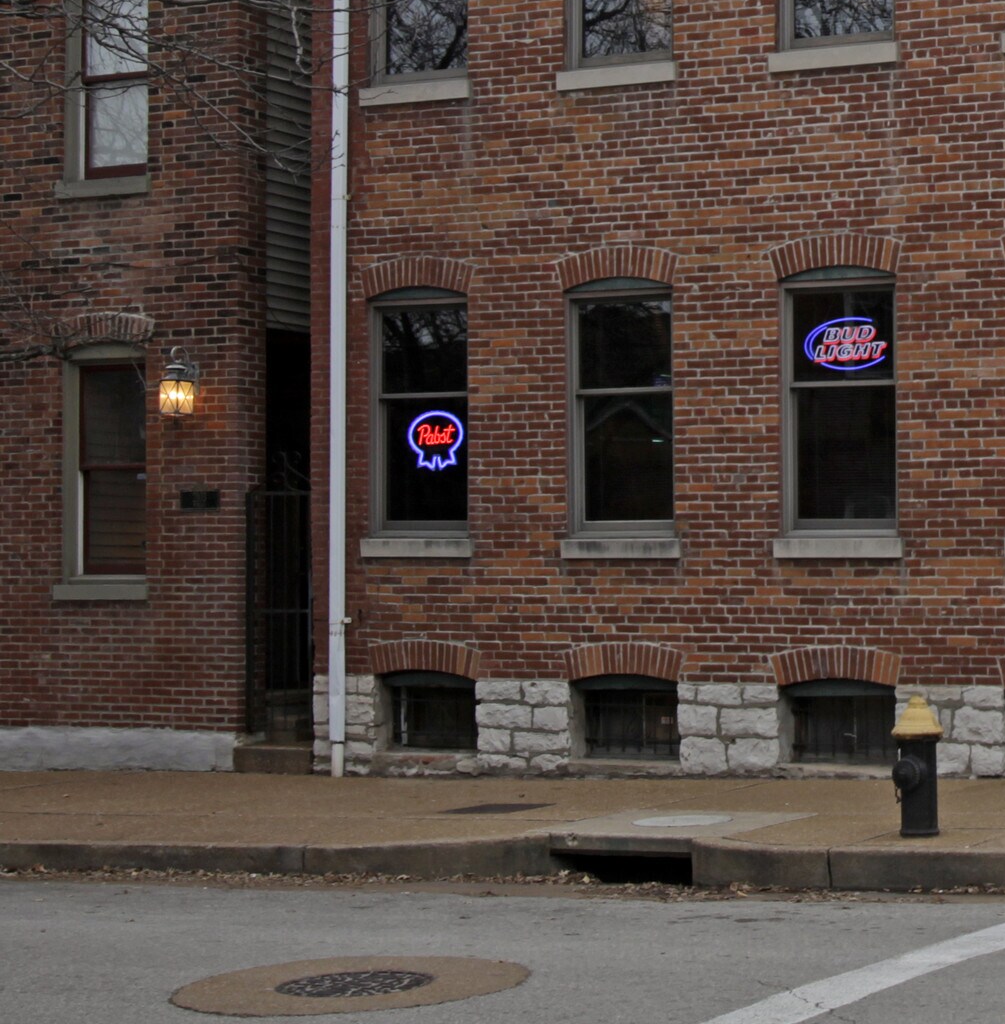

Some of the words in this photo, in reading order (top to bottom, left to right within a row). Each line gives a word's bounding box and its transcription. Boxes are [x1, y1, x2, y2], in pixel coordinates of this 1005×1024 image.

[823, 325, 876, 345] BUD
[814, 341, 888, 363] LIGHT
[417, 424, 456, 445] Pabst
